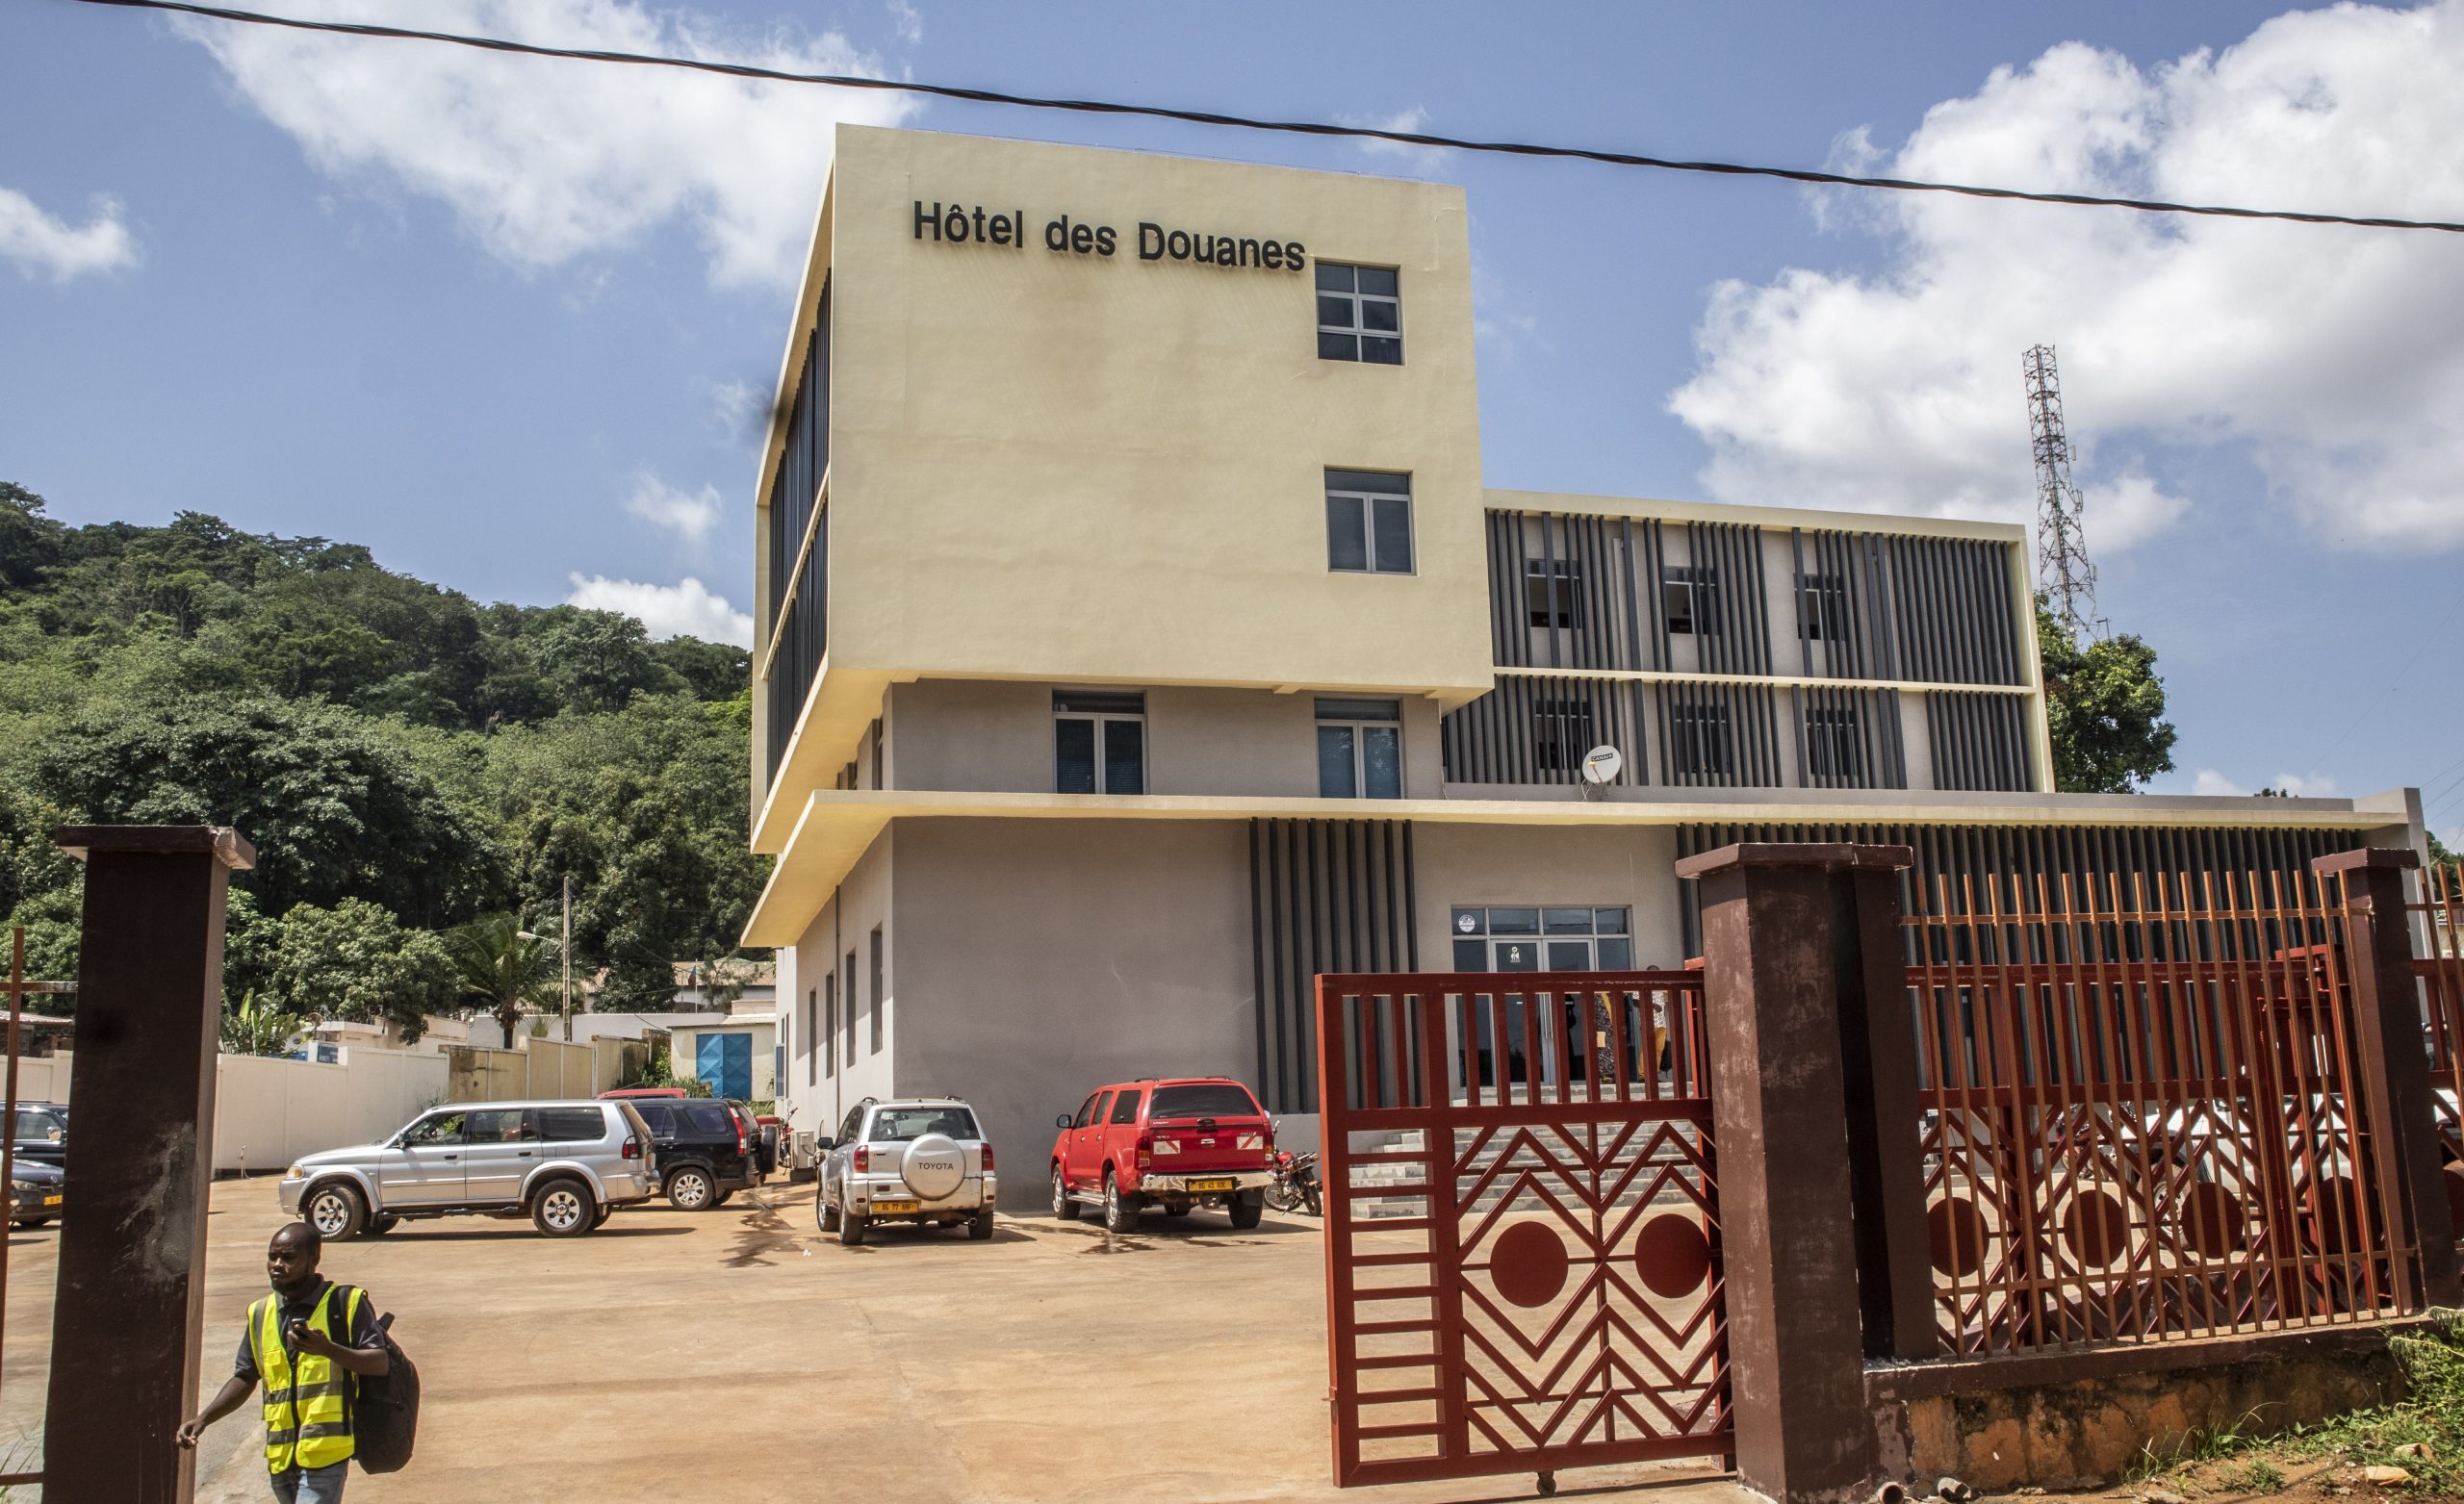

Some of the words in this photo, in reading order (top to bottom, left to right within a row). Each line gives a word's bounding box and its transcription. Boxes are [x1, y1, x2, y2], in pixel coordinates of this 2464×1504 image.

[913, 200, 1023, 248] Hôtel
[1044, 215, 1117, 257] des
[1138, 222, 1306, 271] Douanes
